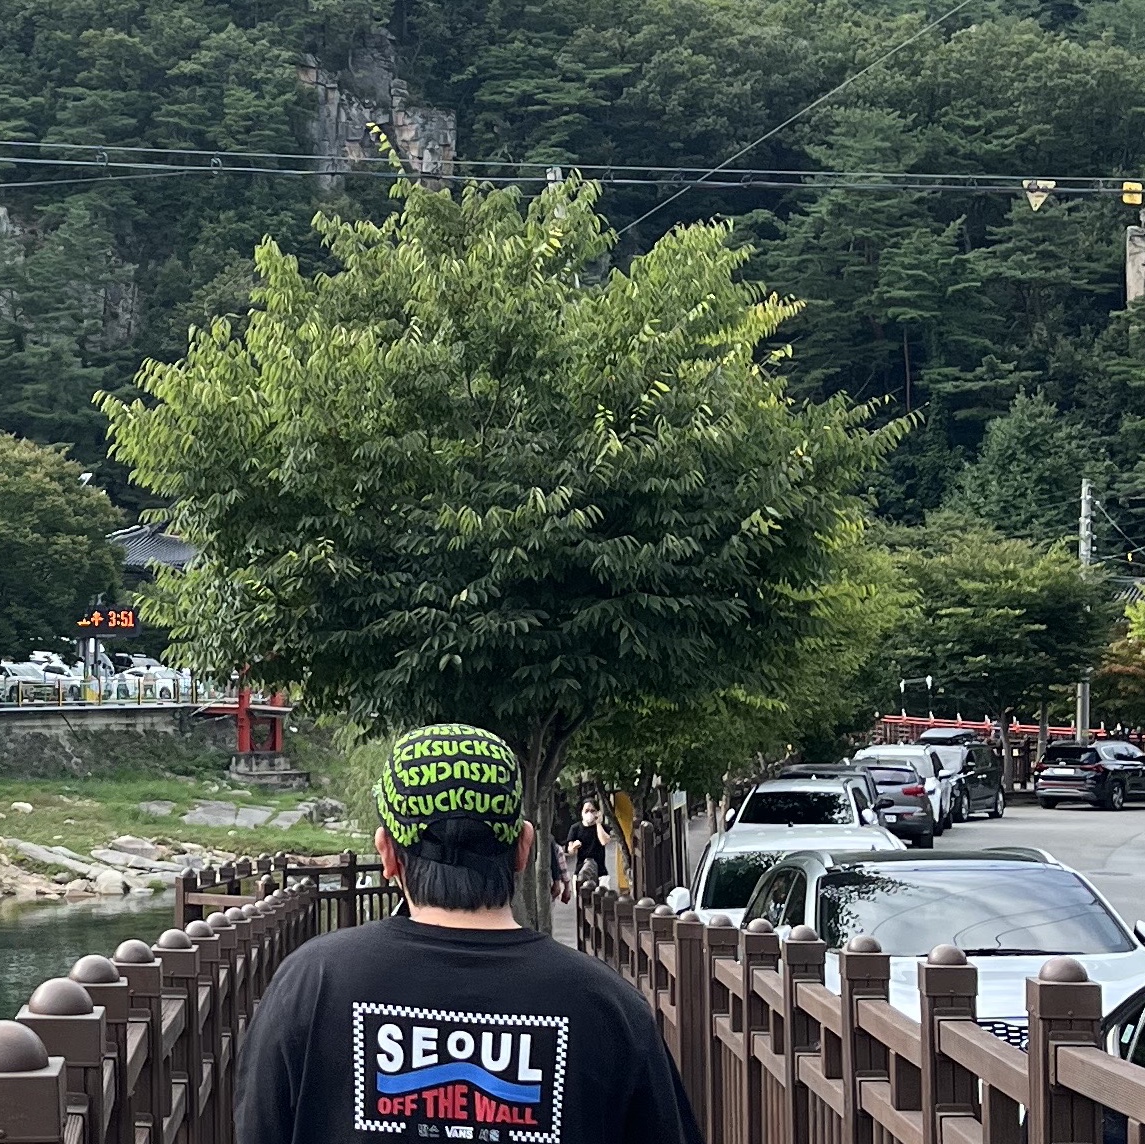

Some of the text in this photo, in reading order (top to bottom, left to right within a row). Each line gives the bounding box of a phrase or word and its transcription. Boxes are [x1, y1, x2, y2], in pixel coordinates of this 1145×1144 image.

[108, 610, 135, 627] 3:51
[376, 1023, 543, 1082] SEOUL
[377, 1084, 538, 1125] OFF THE WALL
[445, 1125, 475, 1140] VANS
